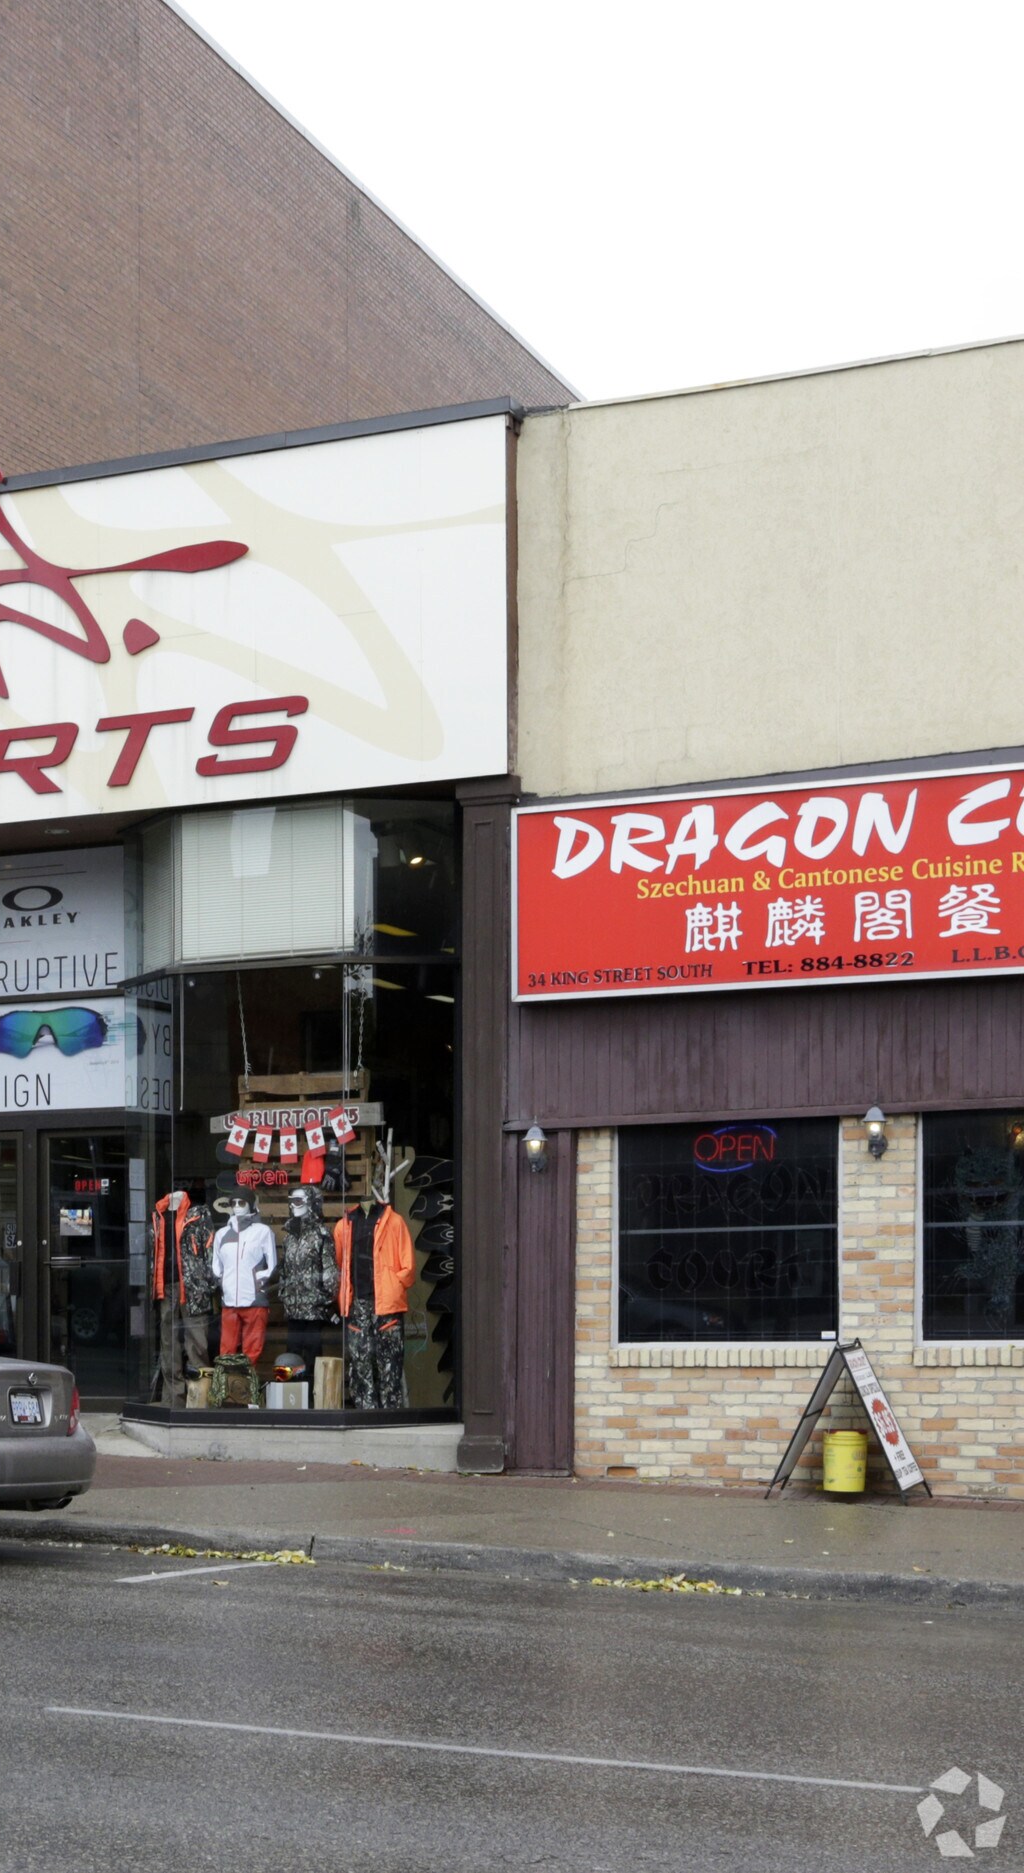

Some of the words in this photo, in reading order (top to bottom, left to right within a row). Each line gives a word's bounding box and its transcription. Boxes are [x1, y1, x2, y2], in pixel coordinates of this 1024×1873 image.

[551, 788, 917, 879] DRAGON
[636, 876, 745, 901] Szechuan
[752, 871, 771, 892] &
[778, 864, 903, 890] Cantonese
[912, 854, 1003, 880] Cuisine
[528, 973, 546, 987] 34
[550, 970, 589, 986] KING
[593, 966, 652, 985] STREET
[657, 963, 713, 981] SOUTH
[742, 959, 794, 976] TEL:
[800, 950, 915, 973] 884-8822
[694, 1133, 775, 1162] OPEN
